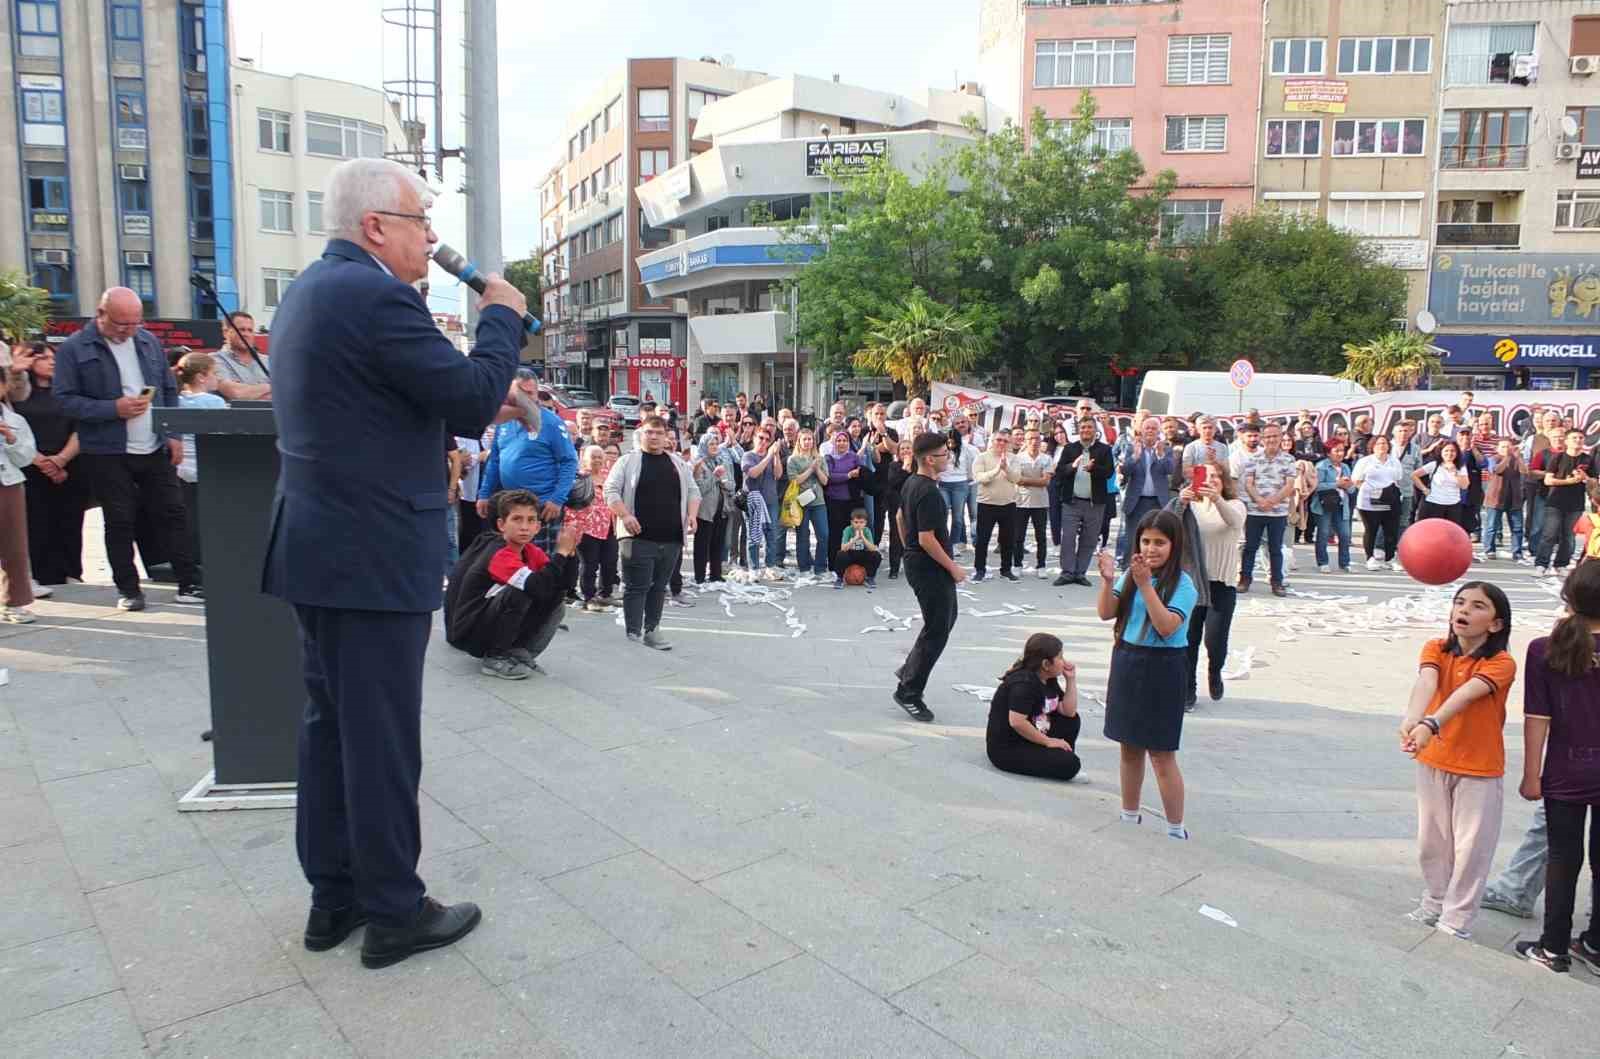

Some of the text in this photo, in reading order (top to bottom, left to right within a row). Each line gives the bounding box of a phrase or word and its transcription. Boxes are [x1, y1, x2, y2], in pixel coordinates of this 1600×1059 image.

[808, 141, 885, 156] SARIBAŞ
[1460, 263, 1547, 279] Turkcell'le
[1459, 280, 1520, 298] bağlan
[1457, 297, 1526, 316] hayata!
[1519, 344, 1597, 358] TURKCELL
